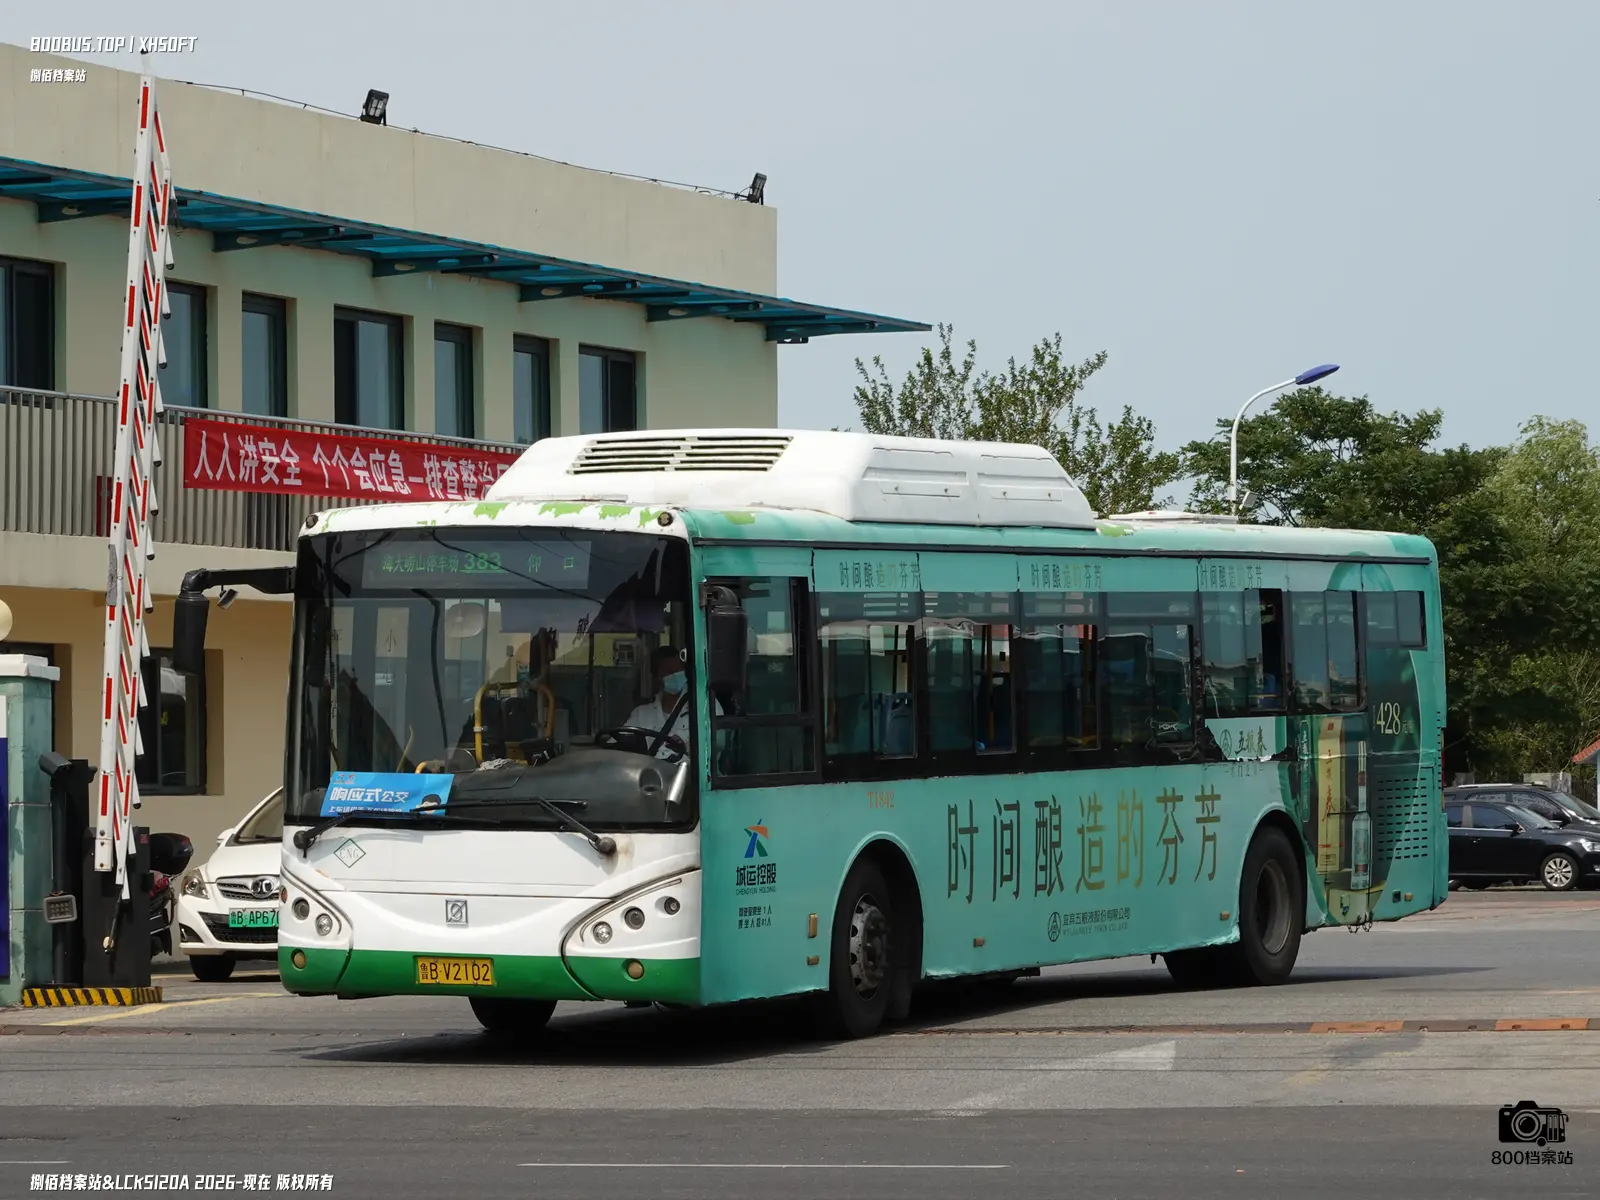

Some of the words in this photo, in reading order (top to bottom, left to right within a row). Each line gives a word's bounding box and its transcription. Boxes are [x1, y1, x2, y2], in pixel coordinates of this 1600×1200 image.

[193, 430, 302, 486] 人人讲安全
[464, 552, 501, 570] 383
[1376, 702, 1401, 735] 428
[330, 787, 409, 803] 响应式公交
[340, 847, 359, 860] CNG
[947, 784, 1223, 904] 时间酿造的芬芳
[736, 863, 777, 886] 城运控股
